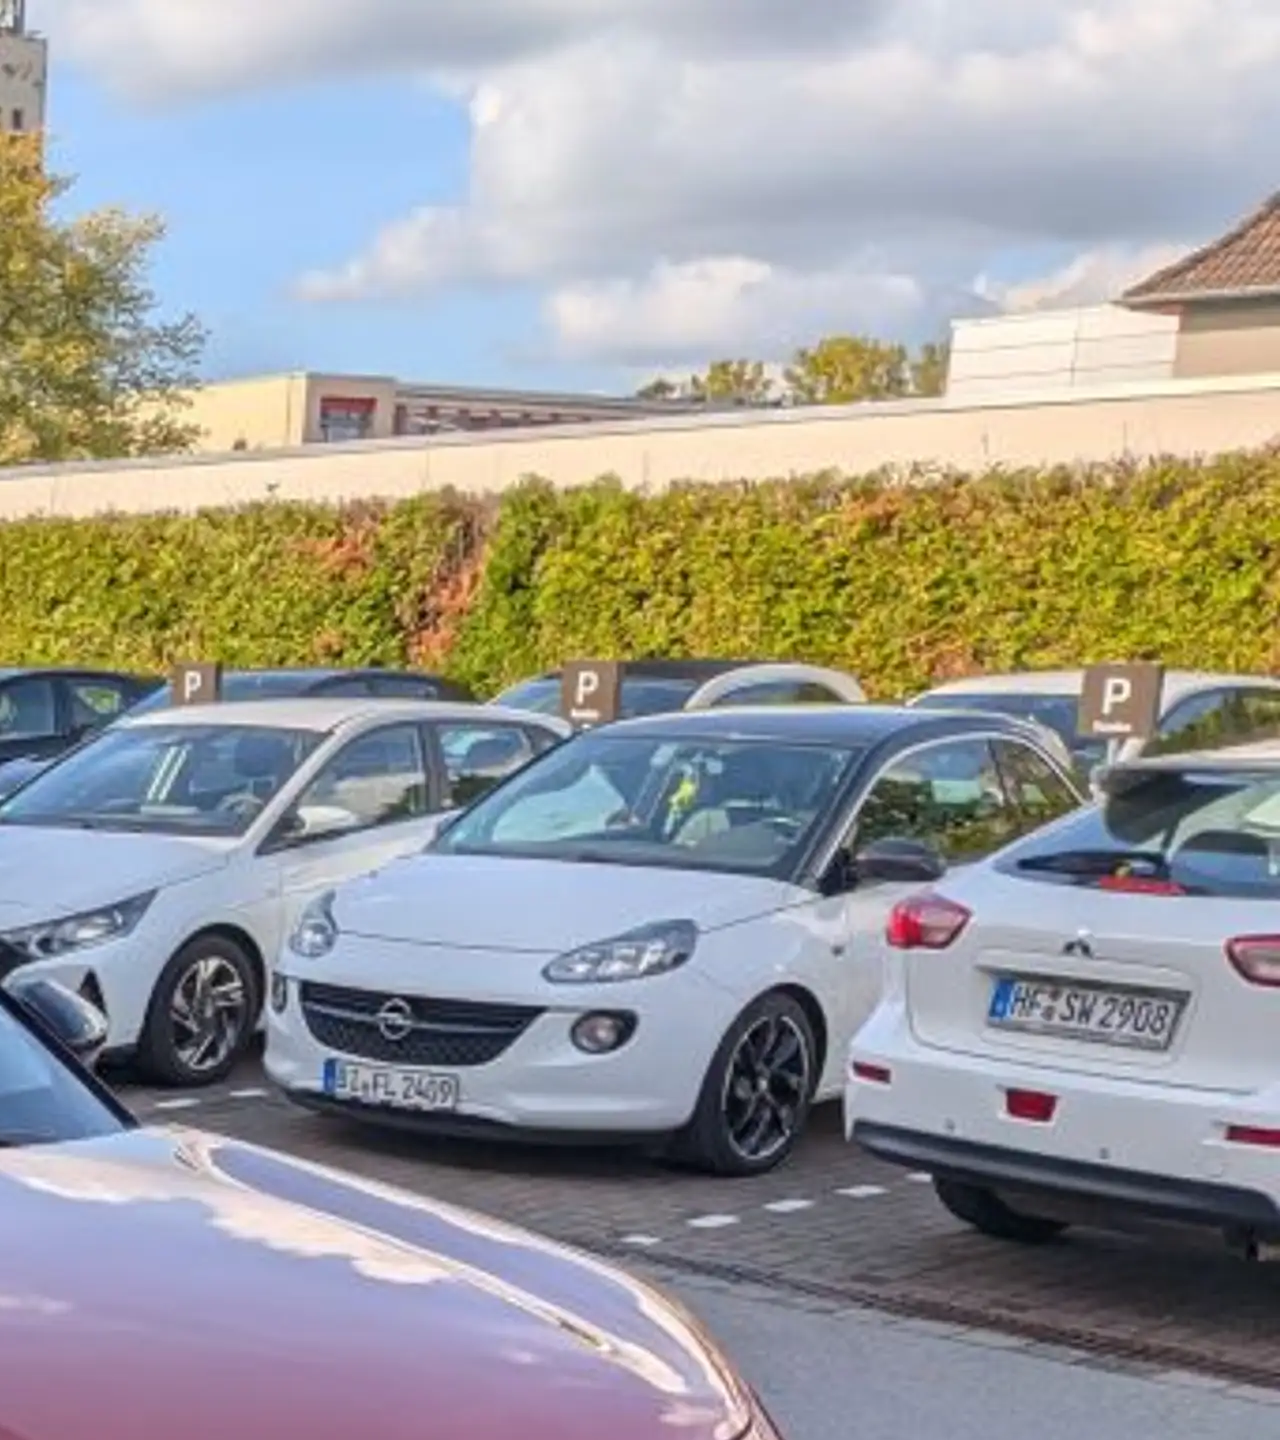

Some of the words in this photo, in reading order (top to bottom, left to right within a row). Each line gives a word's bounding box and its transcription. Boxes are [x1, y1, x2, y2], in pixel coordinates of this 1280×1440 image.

[184, 670, 201, 700] P
[576, 670, 599, 705] P
[1101, 677, 1132, 715] P
[1098, 996, 1169, 1036] 2908
